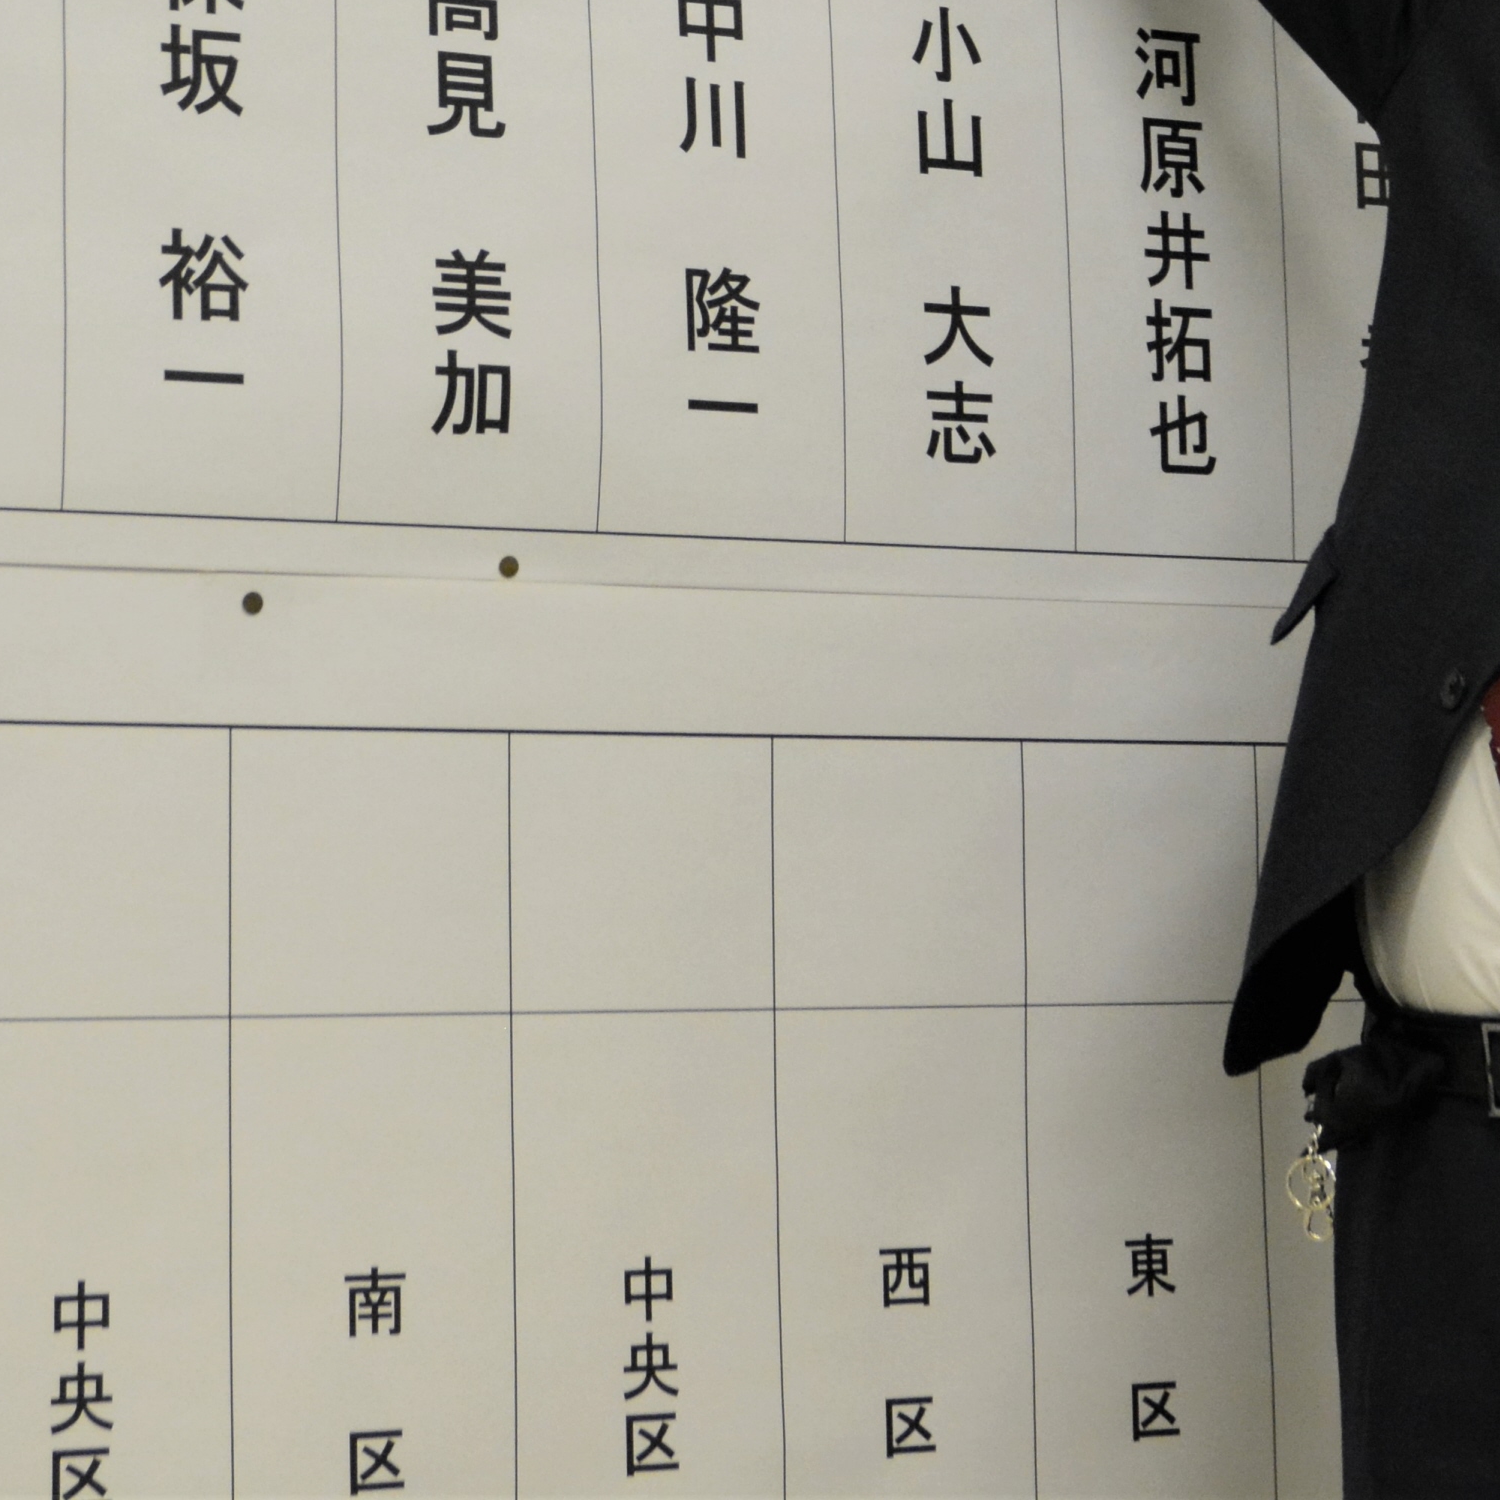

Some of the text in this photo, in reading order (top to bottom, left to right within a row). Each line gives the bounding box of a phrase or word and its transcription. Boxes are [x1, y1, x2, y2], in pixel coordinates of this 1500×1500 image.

[159, 228, 248, 384] 裕一
[431, 249, 511, 434] 美加
[686, 267, 760, 413] 隆一
[913, 7, 996, 464] 小山 大志
[1135, 27, 1216, 475] 河原井拓也
[51, 1281, 113, 1500] 中央区
[345, 1267, 406, 1496] 南区
[624, 1257, 679, 1476] 中央区
[879, 1247, 936, 1458] 西区
[1125, 1233, 1180, 1441] 東区
